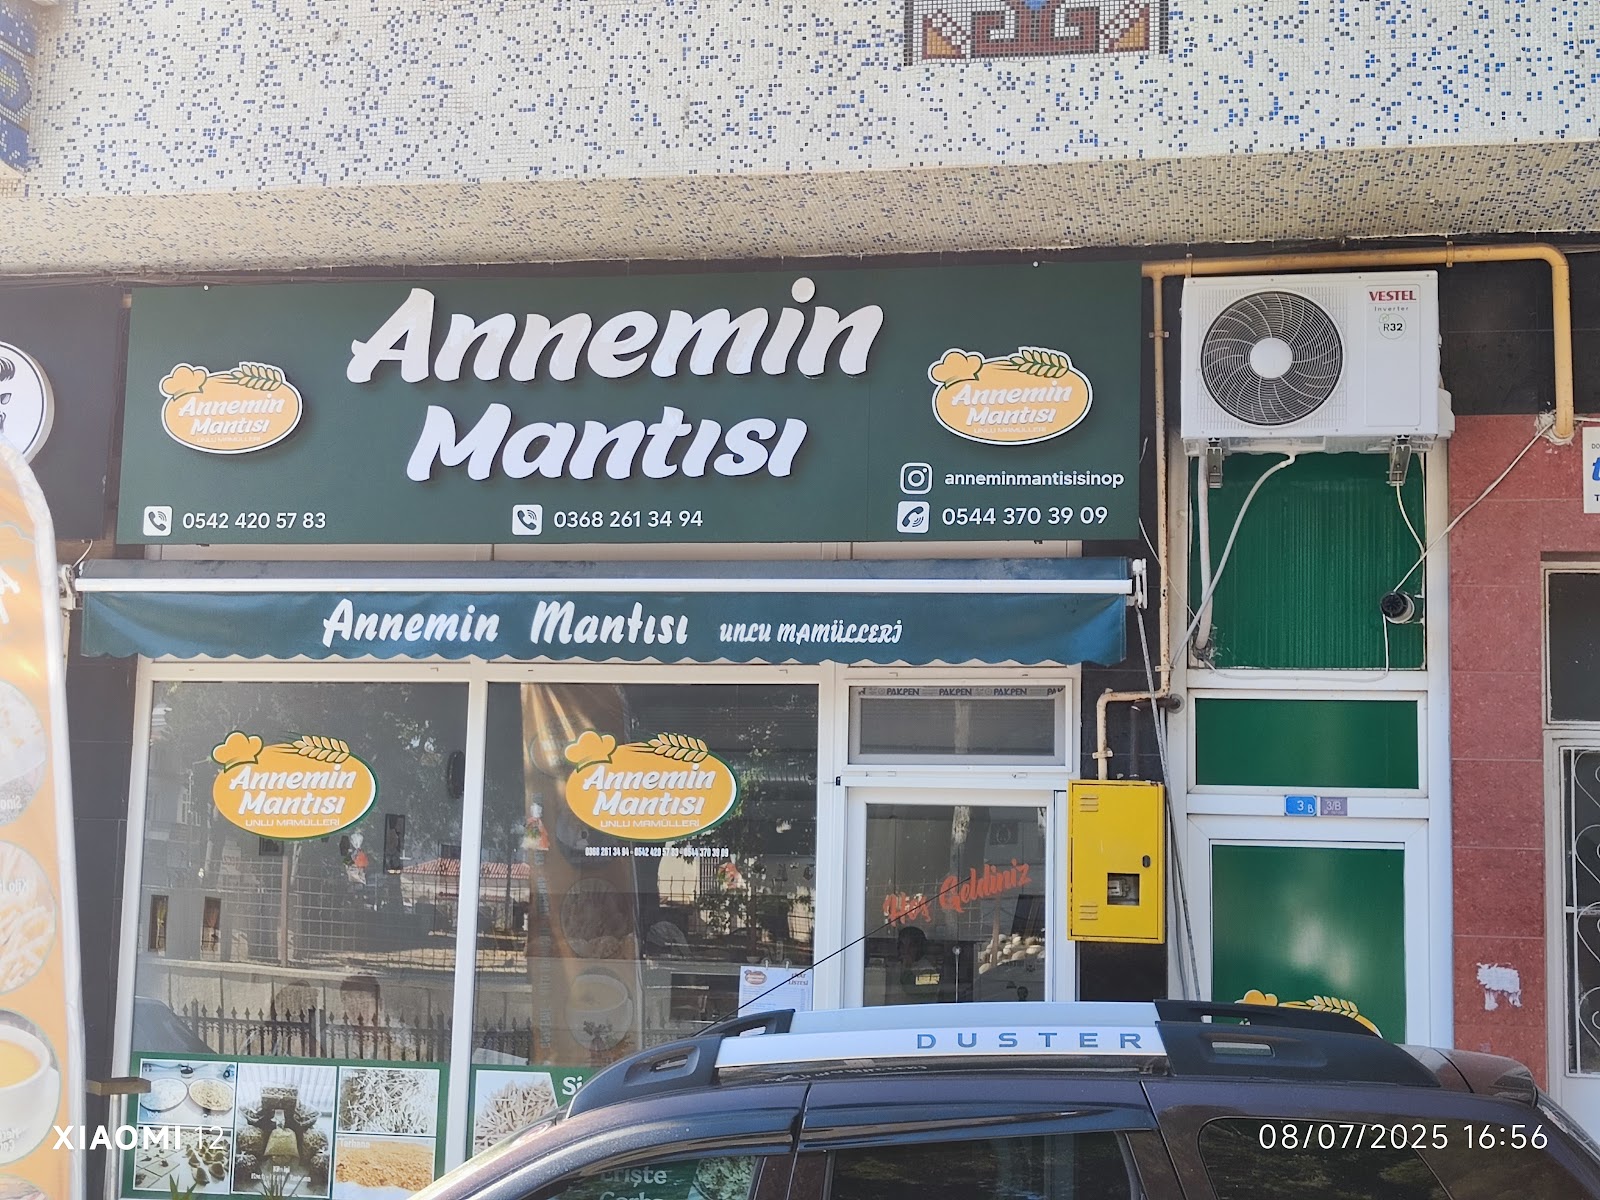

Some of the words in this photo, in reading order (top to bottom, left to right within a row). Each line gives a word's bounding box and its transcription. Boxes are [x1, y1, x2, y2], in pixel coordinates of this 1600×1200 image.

[1368, 290, 1417, 301] VESTEL
[346, 277, 883, 383] Annemin
[1383, 322, 1403, 331] R32
[951, 379, 1073, 406] Annemin
[178, 393, 286, 417] Annemin
[965, 406, 1057, 426] Mantısı
[190, 417, 271, 436] Mantısı
[406, 402, 808, 482] Mantısı
[944, 471, 1125, 488] anneminmantisisinop
[182, 512, 229, 529] 0542
[234, 512, 271, 529] 420
[276, 512, 297, 529] 57
[302, 512, 326, 529] 83
[553, 510, 604, 528] 0368
[609, 510, 641, 528] 261
[647, 510, 673, 527] 34
[678, 510, 703, 527] 94
[942, 508, 996, 525] 0544
[1002, 507, 1041, 525] 370
[1047, 507, 1074, 525] 39
[1079, 506, 1108, 525] 09
[322, 598, 501, 648] Annemin
[530, 600, 689, 644] Mantısı
[719, 622, 772, 643] UNLU
[886, 688, 920, 696] PAKPEN
[939, 688, 972, 696] PAKPEN
[993, 688, 1027, 696] PAKPEN
[229, 764, 357, 791] Annemin
[582, 763, 716, 791] Annemin
[238, 791, 346, 815] Mantısı
[592, 791, 705, 816] Mantısı
[1297, 799, 1304, 811] 3
[1326, 800, 1342, 811] 3/B
[245, 818, 274, 827] UNLU
[600, 819, 631, 828] UNLU
[939, 858, 1032, 912] Geldiniz
[917, 1032, 1142, 1049] DUSTER
